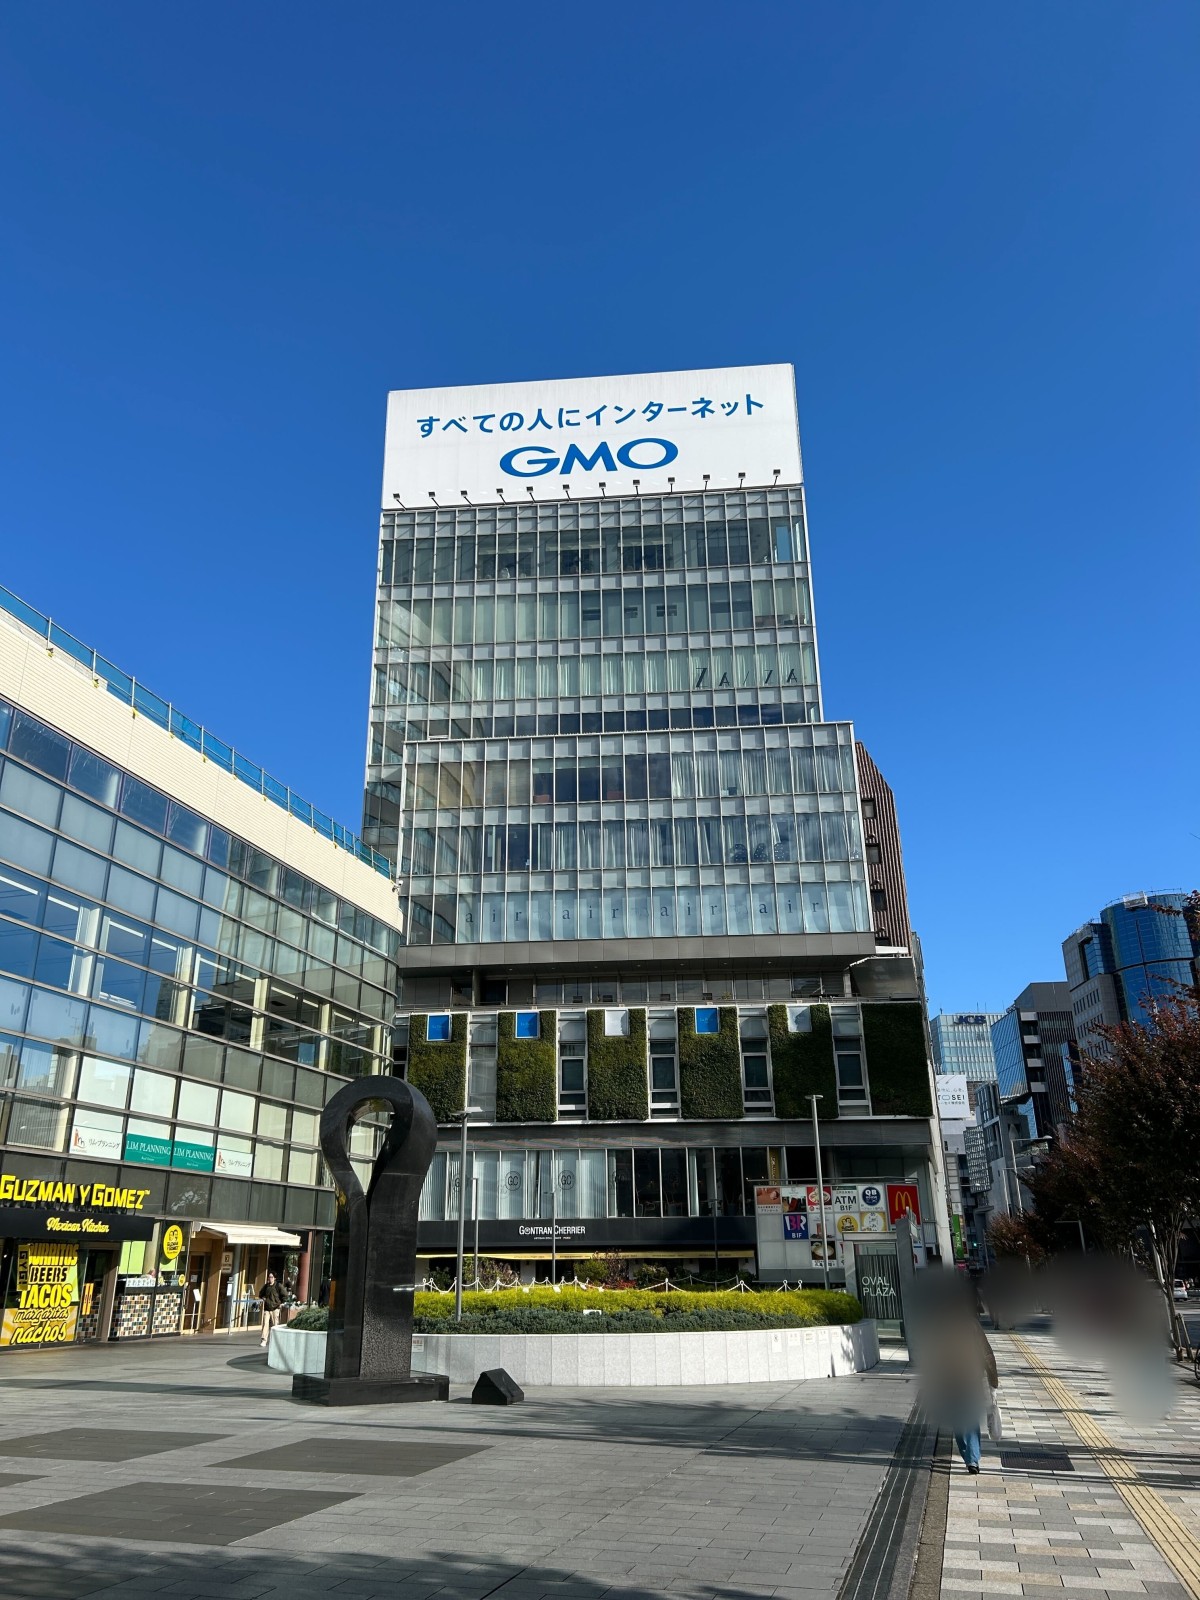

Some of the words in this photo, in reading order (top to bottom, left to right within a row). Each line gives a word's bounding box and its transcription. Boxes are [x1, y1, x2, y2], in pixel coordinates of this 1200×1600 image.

[416, 393, 764, 438] すべての人にインターネット
[499, 437, 679, 478] GMO
[465, 907, 523, 924] air
[562, 904, 620, 921] air
[660, 901, 718, 918] air
[758, 898, 820, 915] air
[953, 1015, 986, 1025] JCB
[126, 1140, 138, 1151] LIM
[139, 1143, 171, 1155] PLANNING
[173, 1147, 185, 1157] LIM
[185, 1149, 214, 1162] PLANNING
[0, 1174, 75, 1203] GUZMAN
[80, 1184, 91, 1206] Y
[91, 1183, 145, 1210] GOMEZ
[834, 1195, 857, 1204] ATM
[46, 1216, 81, 1232] Mexican
[82, 1218, 110, 1234] Kitchen
[519, 1225, 552, 1235] GONTRAN
[554, 1225, 586, 1235] CHERRIER
[29, 1266, 68, 1283] BEERS
[861, 1276, 890, 1286] OVAL
[19, 1284, 73, 1309] TACOS
[862, 1287, 897, 1297] PLAZA
[13, 1307, 70, 1325] margaritas
[11, 1321, 67, 1344] nachos
